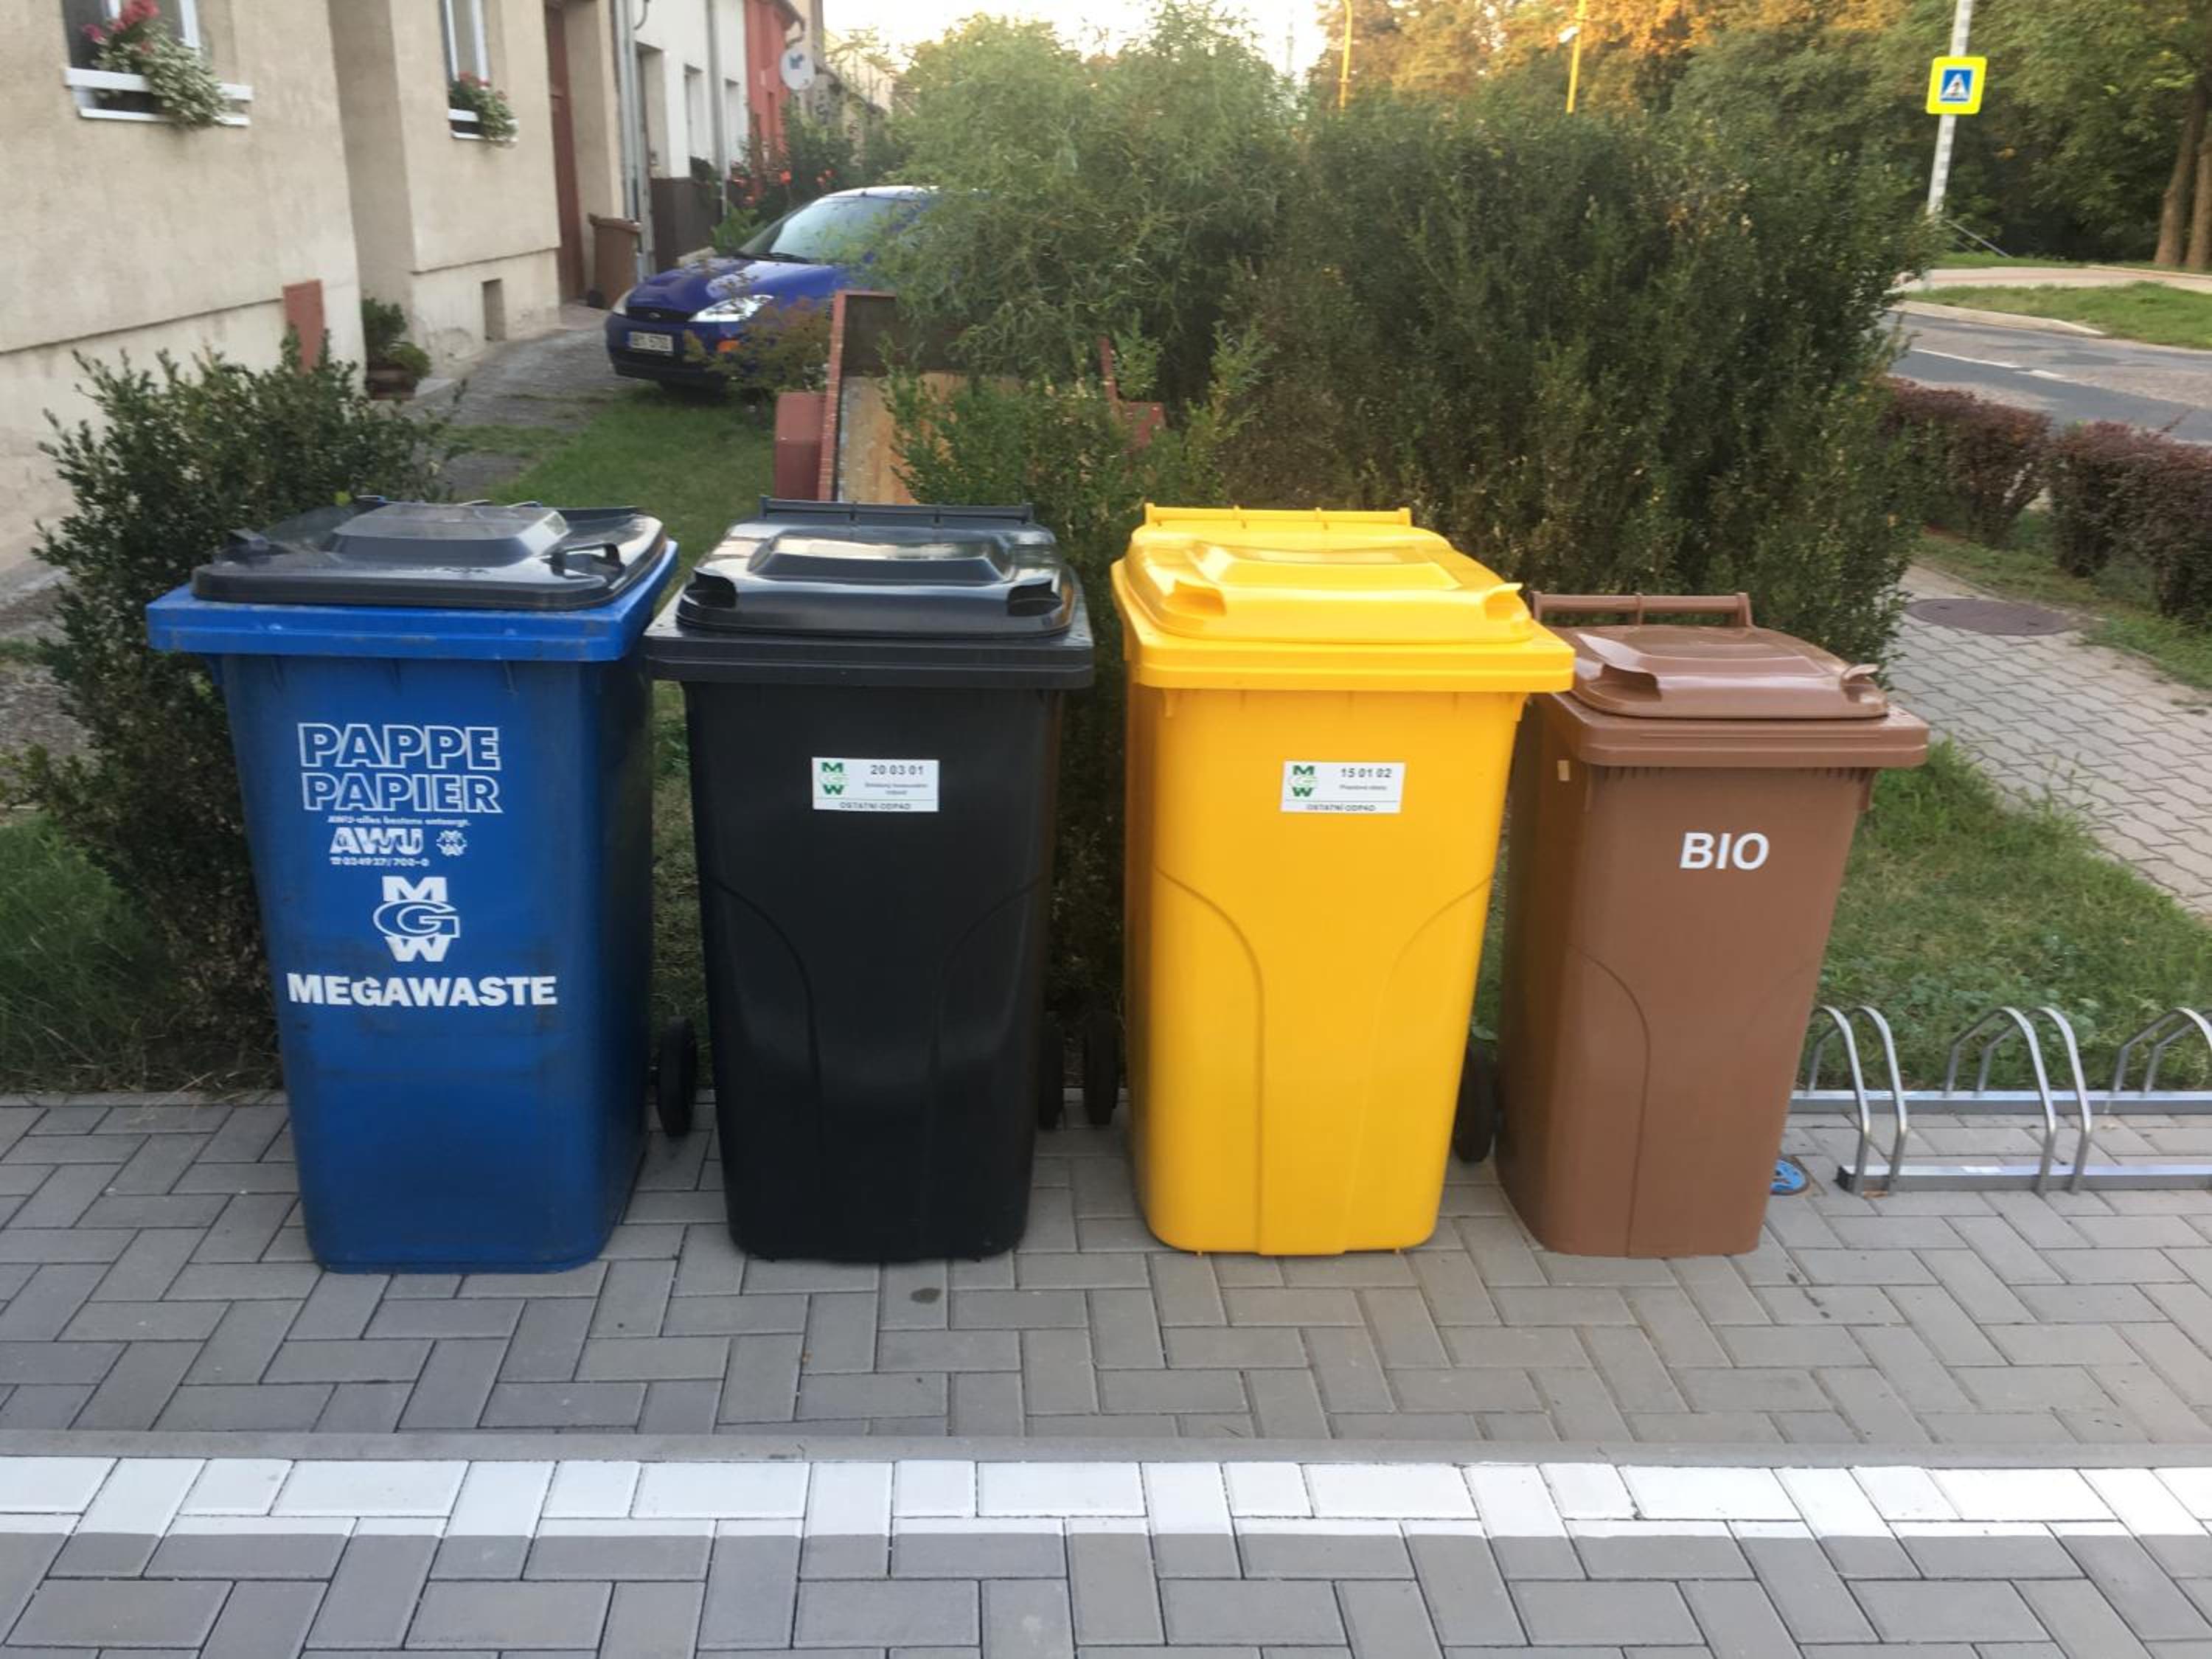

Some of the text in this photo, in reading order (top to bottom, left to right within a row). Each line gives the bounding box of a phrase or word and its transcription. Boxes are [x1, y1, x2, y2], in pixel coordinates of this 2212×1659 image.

[298, 723, 501, 771] PAPPE
[870, 765, 924, 776] 20 03 01
[1341, 768, 1393, 778] 15 01 02
[302, 772, 504, 814] PAPIER
[329, 826, 425, 855] AWU
[1679, 832, 1770, 871] BIO
[287, 972, 558, 1007] MEGAWASTE
